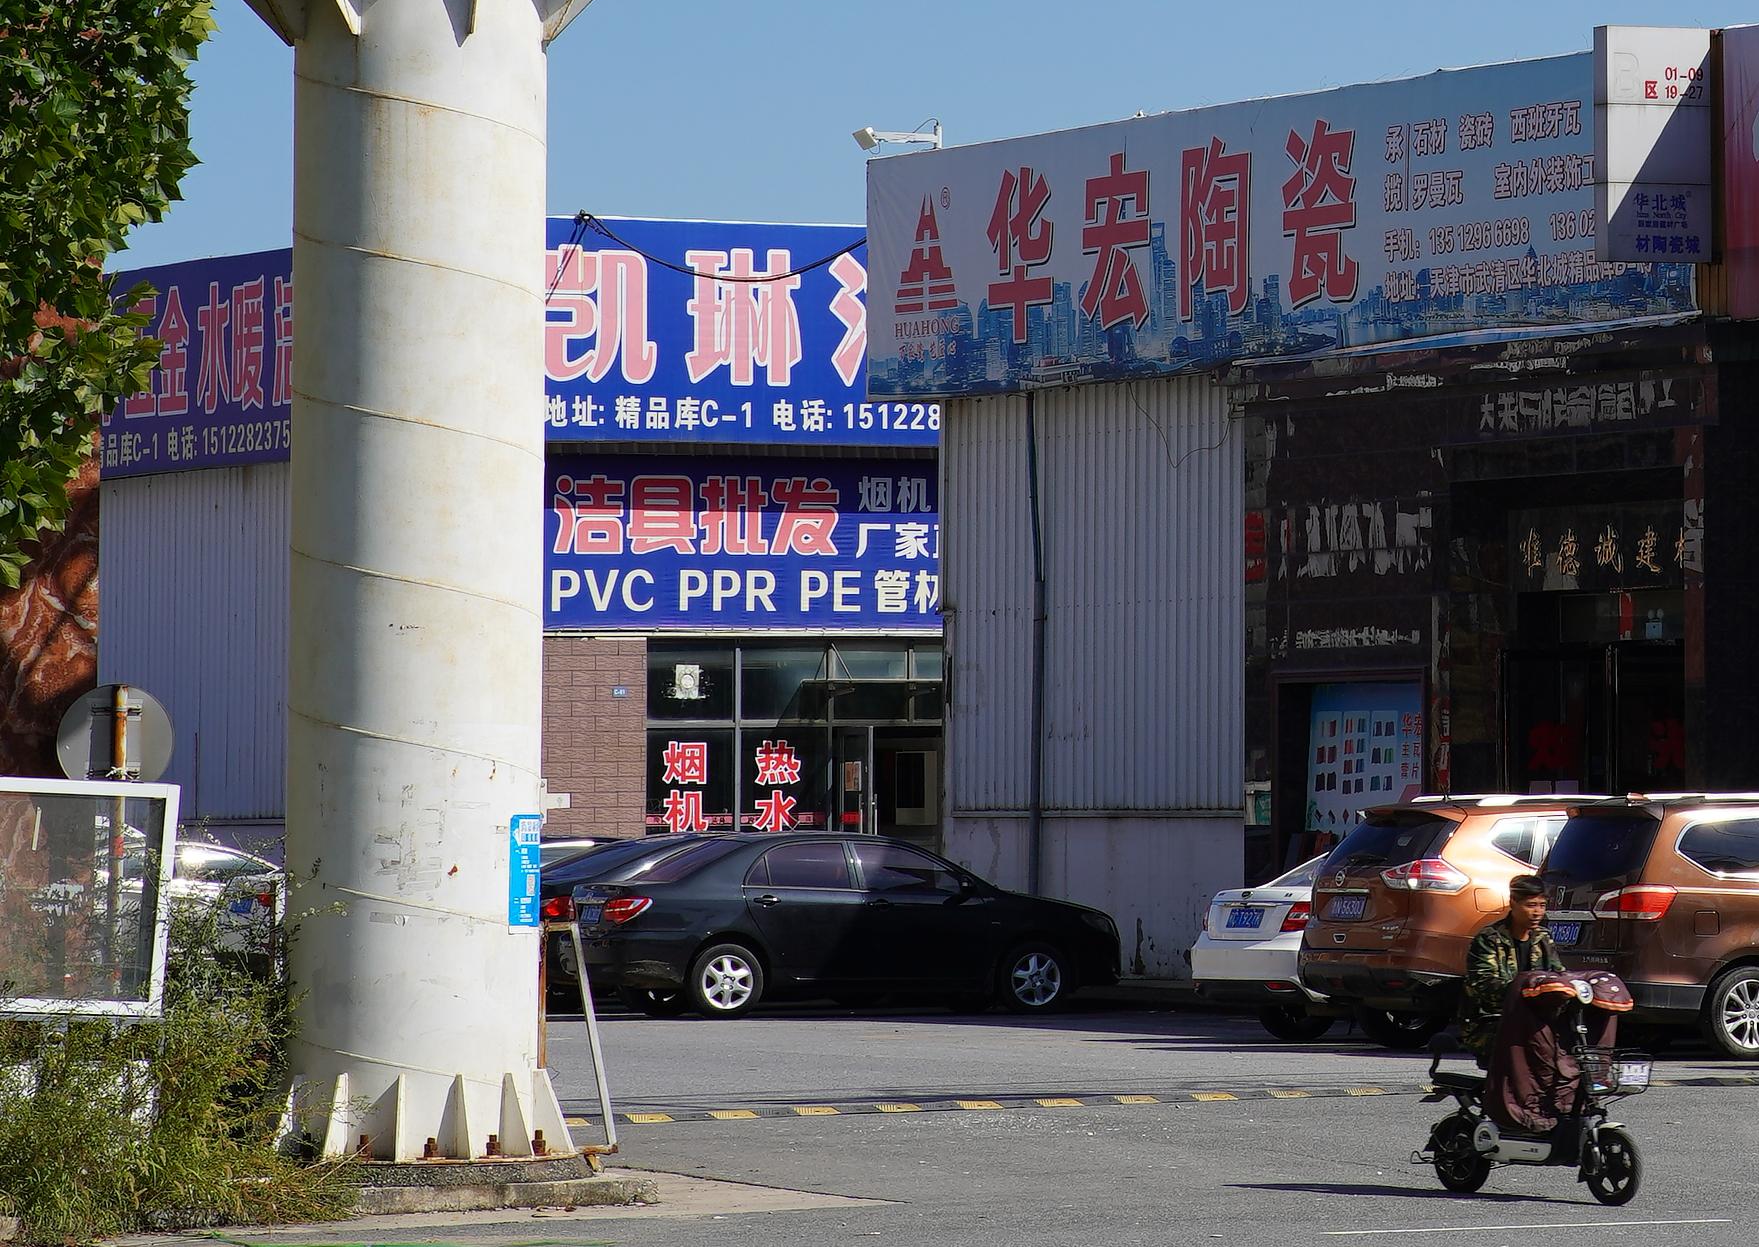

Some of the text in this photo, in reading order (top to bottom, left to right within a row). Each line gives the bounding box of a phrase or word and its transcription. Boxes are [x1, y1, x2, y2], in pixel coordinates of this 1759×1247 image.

[1664, 66, 1704, 82] 01-09
[1664, 84, 1704, 100] 19-27
[1413, 100, 1582, 156] 石材 瓷砖 西班牙瓦
[1413, 170, 1463, 209] 罗曼瓦
[1633, 193, 1687, 212] 华北城
[986, 118, 1360, 345] 华宏陶瓷
[895, 316, 959, 337] HUAHONG
[615, 395, 753, 430] 精品库C-1
[772, 398, 833, 433] 电话:
[858, 476, 932, 514] 烟机
[553, 474, 839, 556] 洁具批发
[855, 522, 939, 560] 厂家
[550, 569, 655, 614] PVC
[679, 569, 777, 613] PPR
[800, 569, 862, 612] PE
[662, 740, 709, 832] 烟机
[754, 740, 801, 832] 热水
